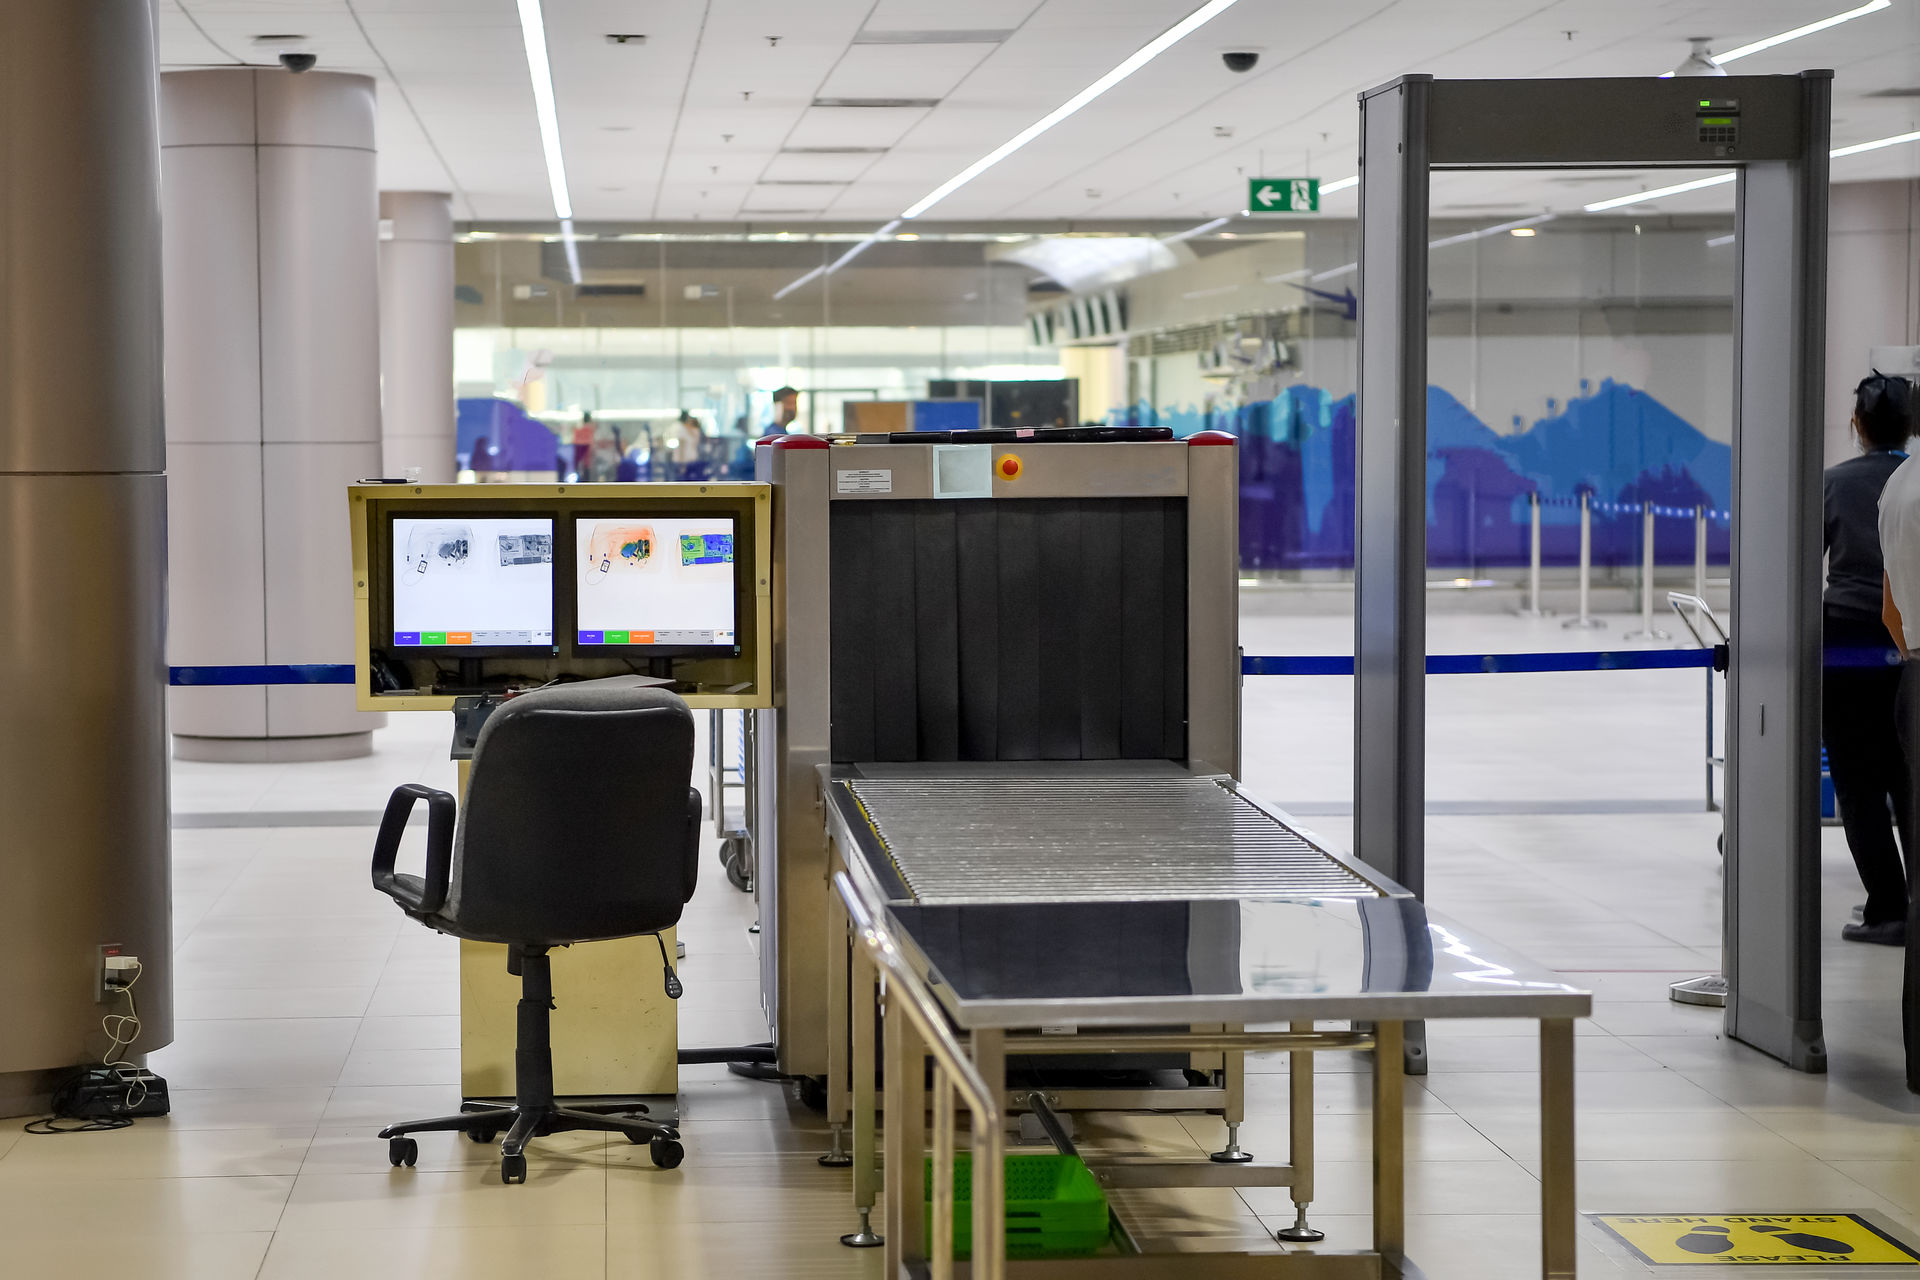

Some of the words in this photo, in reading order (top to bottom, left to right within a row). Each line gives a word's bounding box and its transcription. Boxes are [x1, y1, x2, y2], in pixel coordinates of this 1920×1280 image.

[1615, 1216, 1708, 1224] HERE
[1723, 1216, 1837, 1224] STAND
[1714, 1254, 1851, 1262] PLEASE
